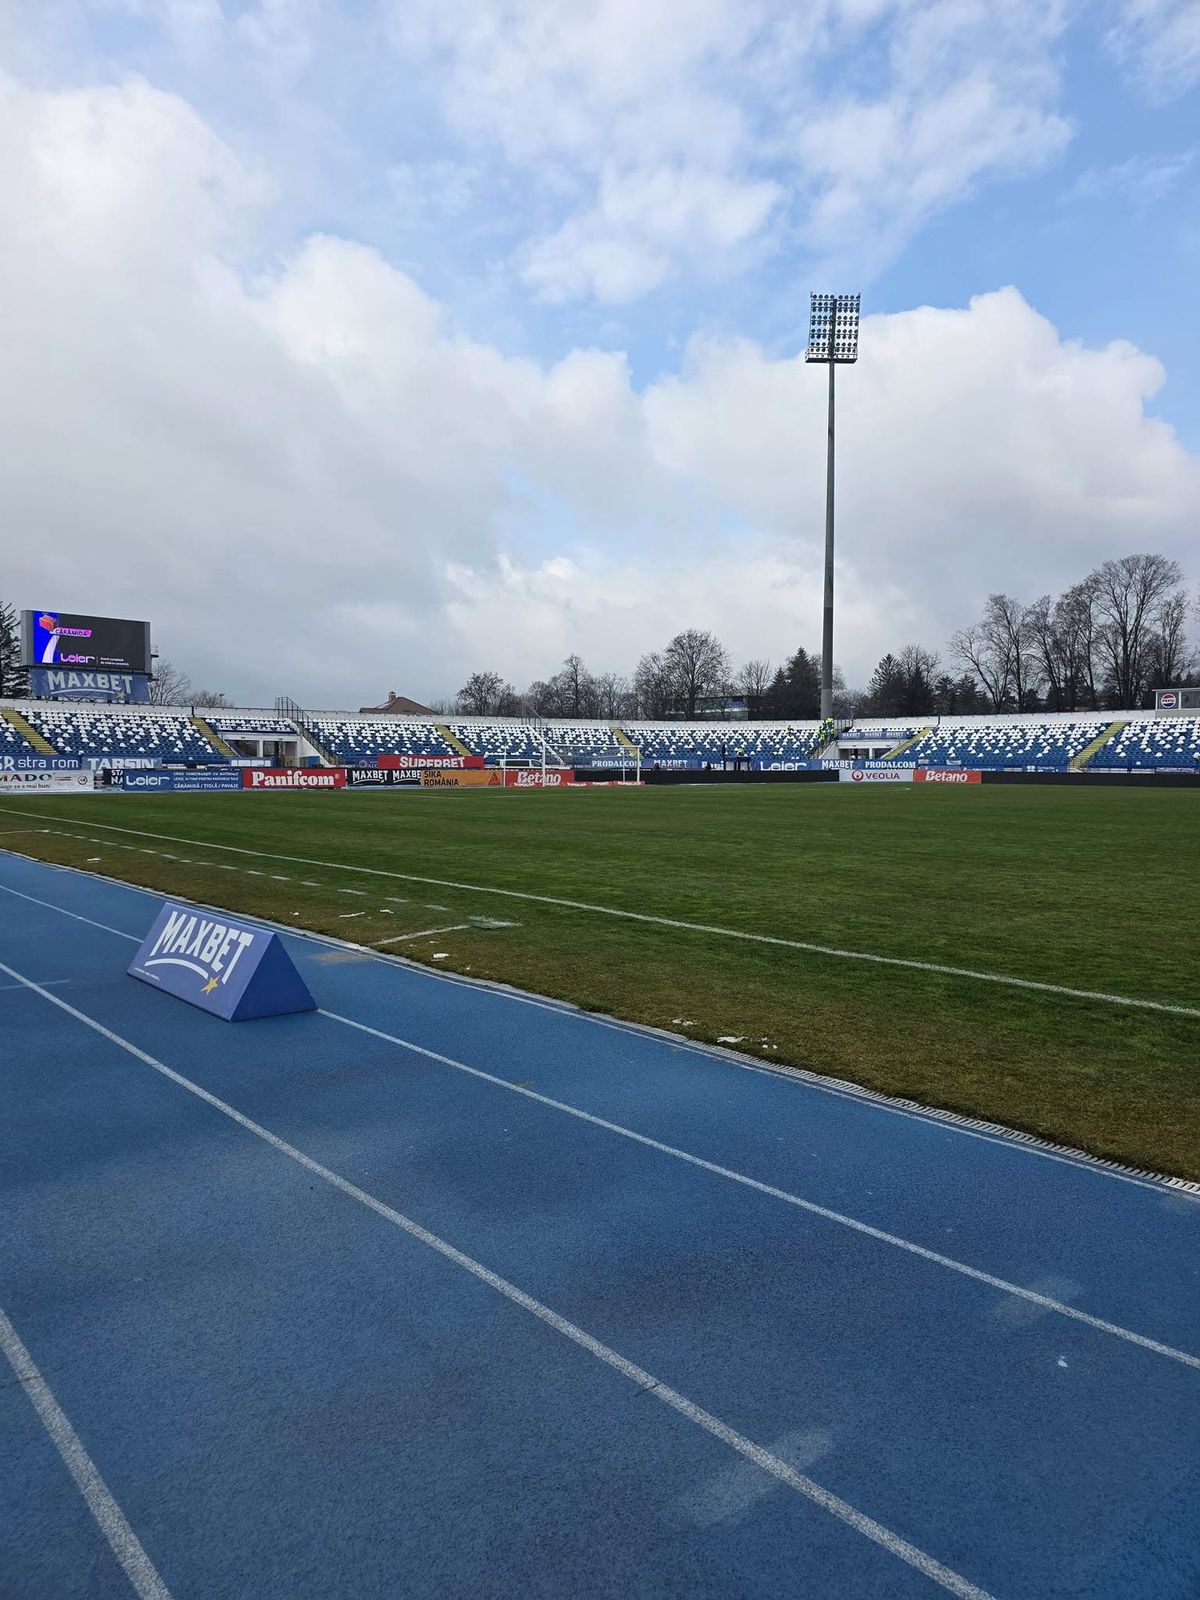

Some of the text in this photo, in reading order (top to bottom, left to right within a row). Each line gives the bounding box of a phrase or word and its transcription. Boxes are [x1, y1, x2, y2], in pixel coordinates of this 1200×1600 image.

[46, 670, 133, 694] MAXBET
[18, 756, 46, 768] stra
[52, 759, 79, 768] rom
[821, 760, 854, 770] MAXBET
[865, 761, 916, 769] PRODALCOM
[251, 770, 335, 786] Panifcom
[352, 770, 388, 782] MAXBET
[392, 770, 421, 781] MAXBE
[865, 772, 900, 780] VEOLIA
[925, 770, 967, 782] Betano
[149, 911, 254, 985] MAXBET
